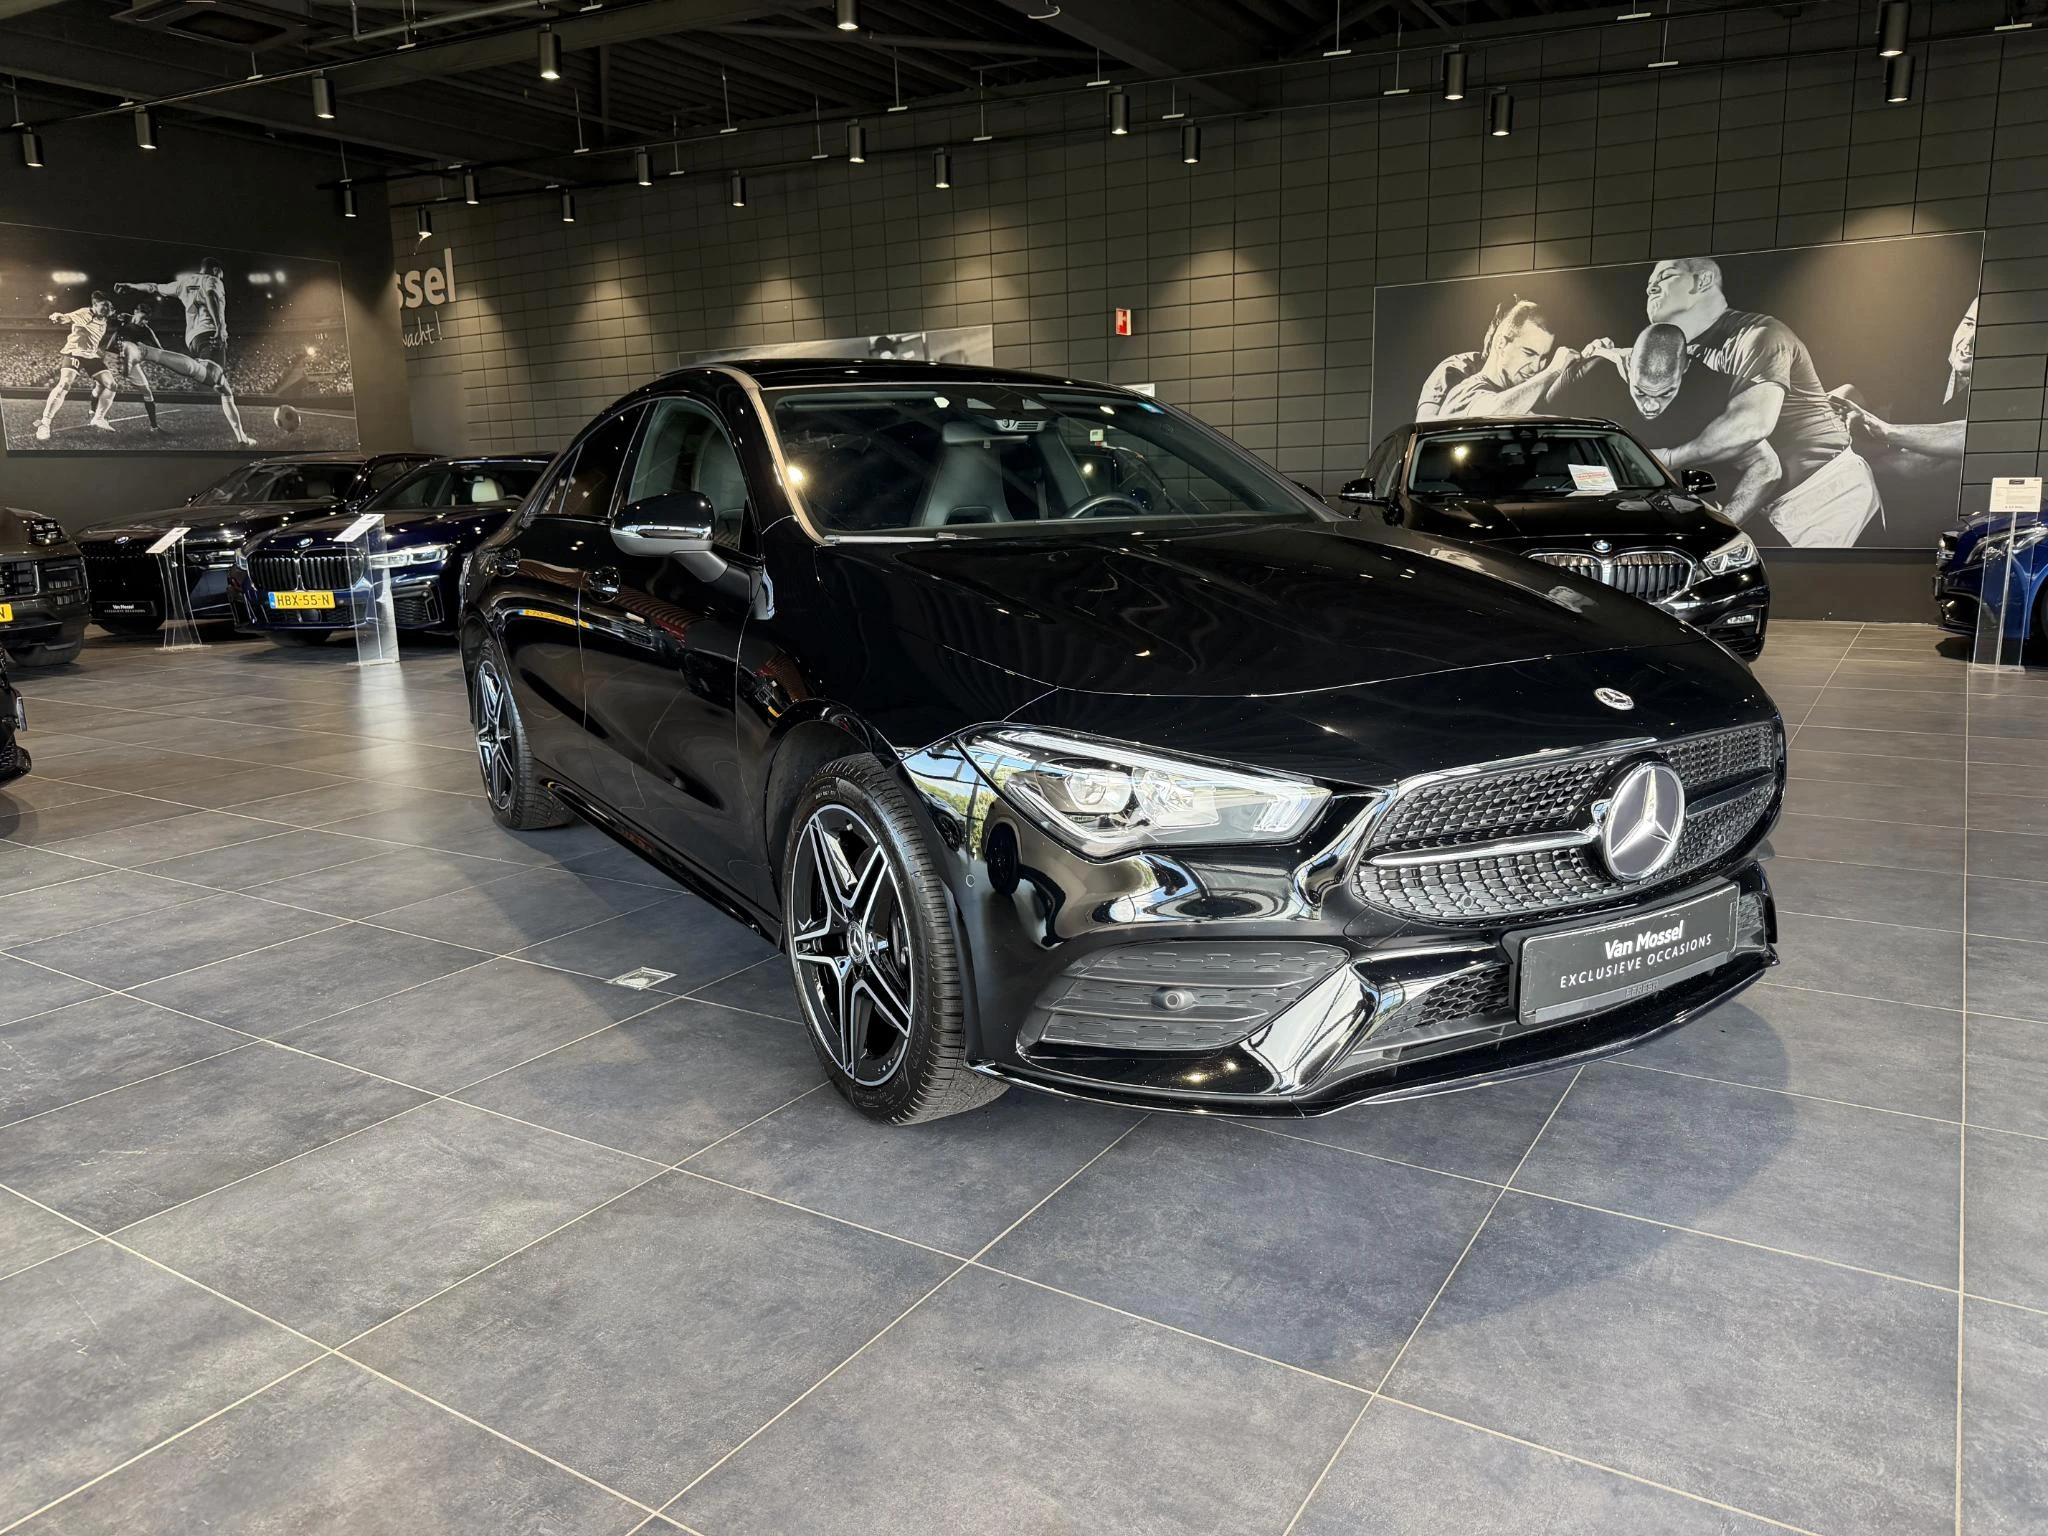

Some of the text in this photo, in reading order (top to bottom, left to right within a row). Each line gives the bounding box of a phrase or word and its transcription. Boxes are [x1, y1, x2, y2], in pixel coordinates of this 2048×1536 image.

[276, 594, 330, 606] HBX-55-N
[1604, 919, 1685, 960] Van Mossel
[1560, 933, 1712, 989] EXCLUSIEVE OCCASIONS
